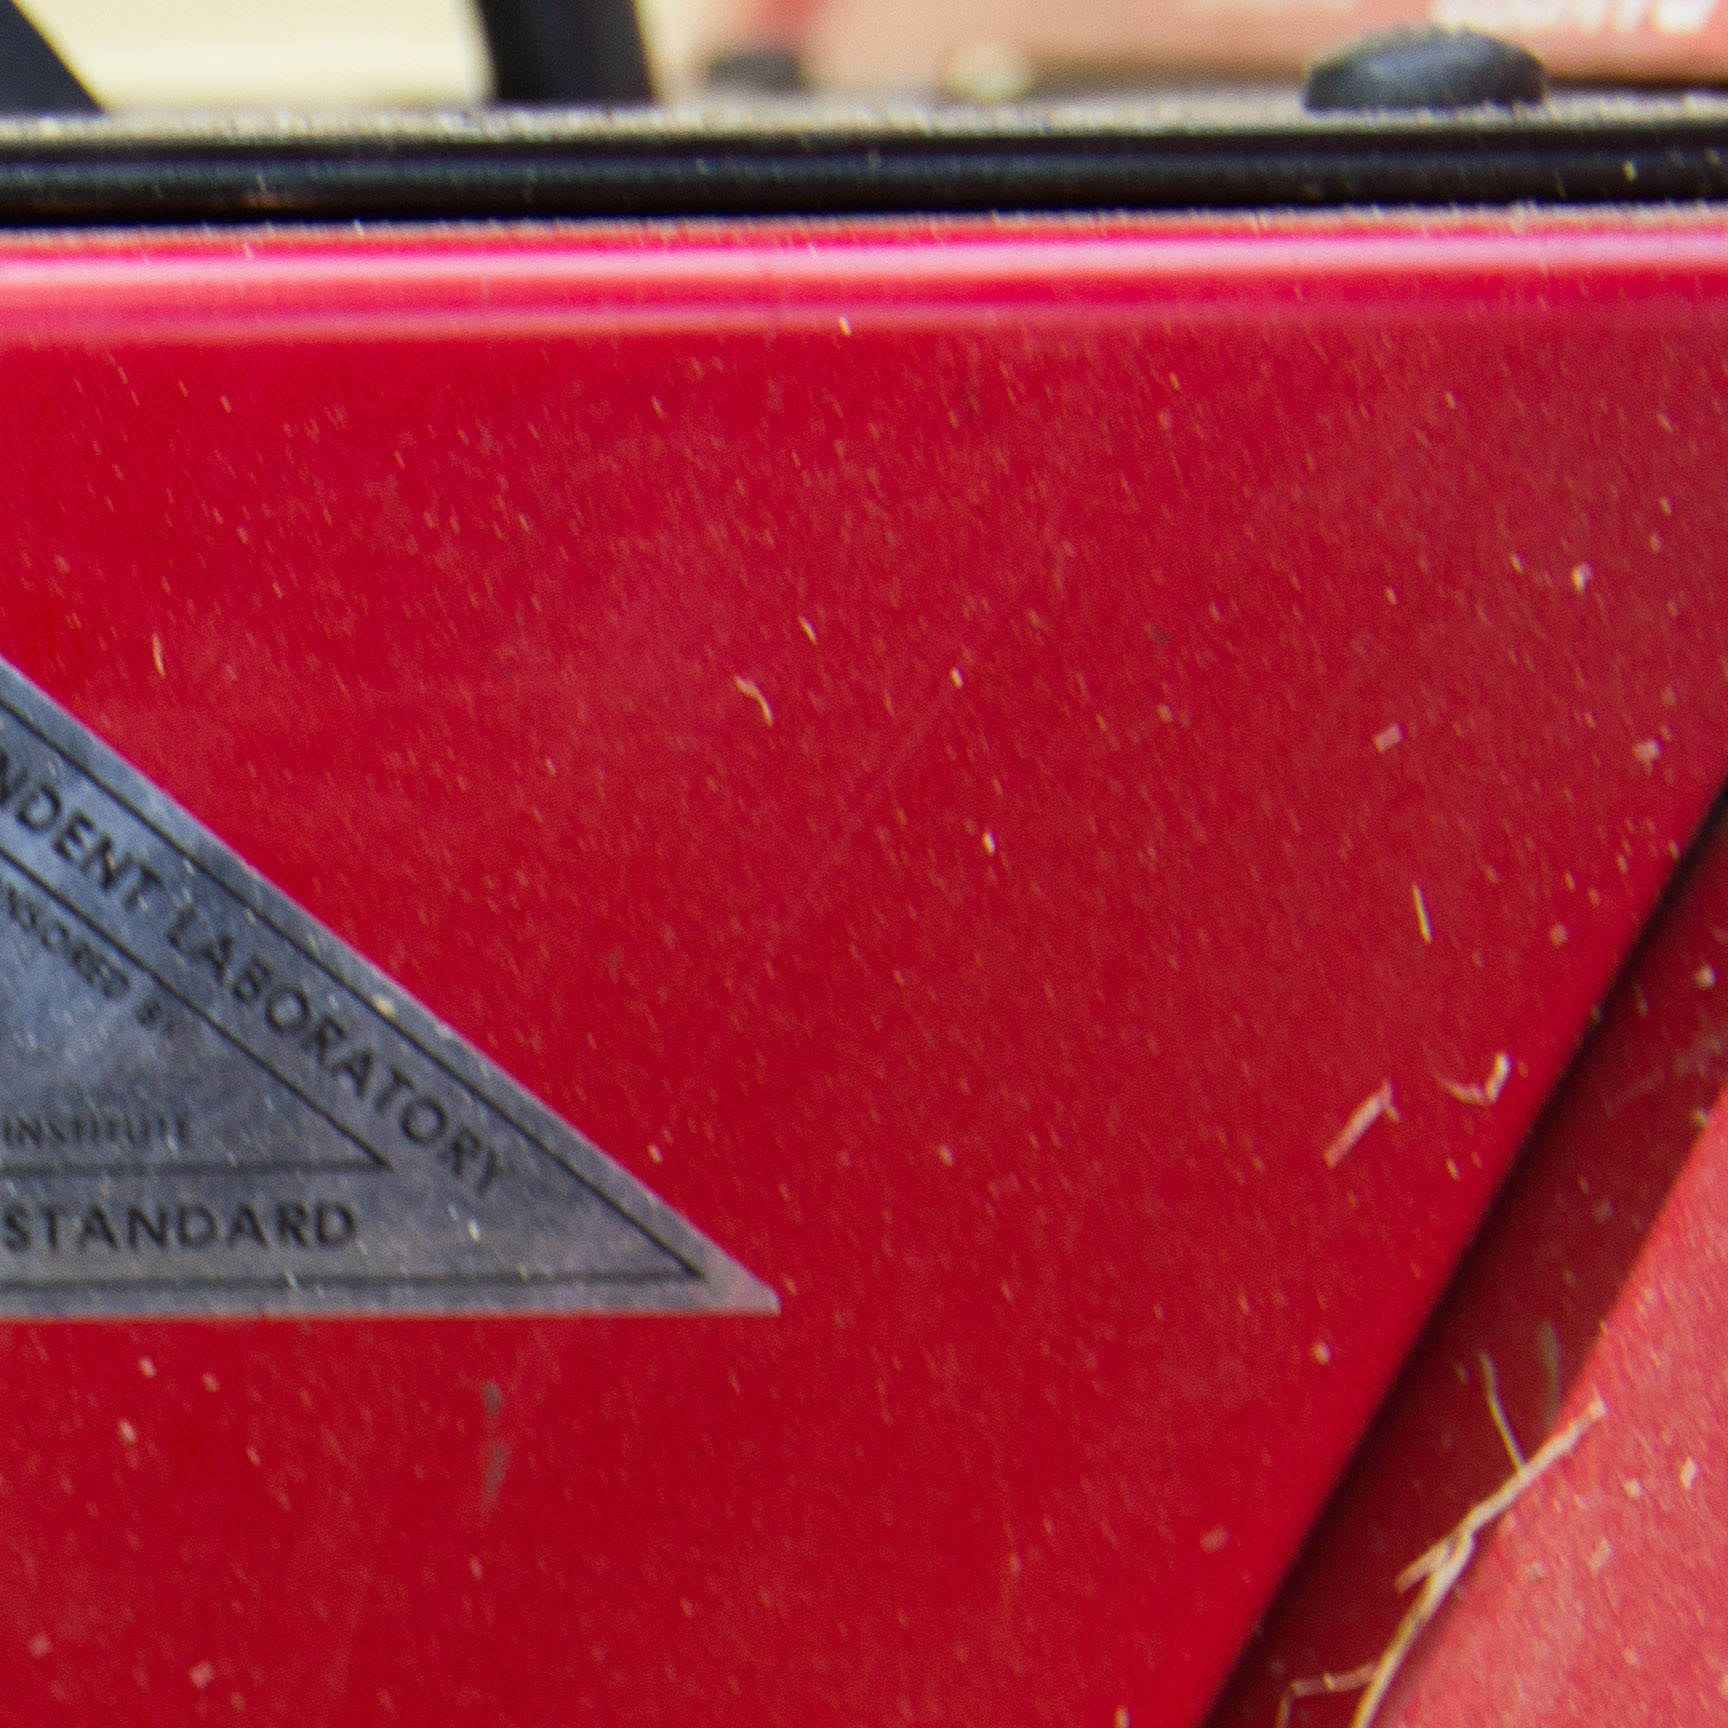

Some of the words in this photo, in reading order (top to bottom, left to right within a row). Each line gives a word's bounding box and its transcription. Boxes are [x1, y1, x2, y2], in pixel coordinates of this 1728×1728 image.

[168, 903, 512, 1196] LABORATORY
[1, 1112, 190, 1150] INSTITUTE
[1, 1201, 358, 1250] STANDARD
